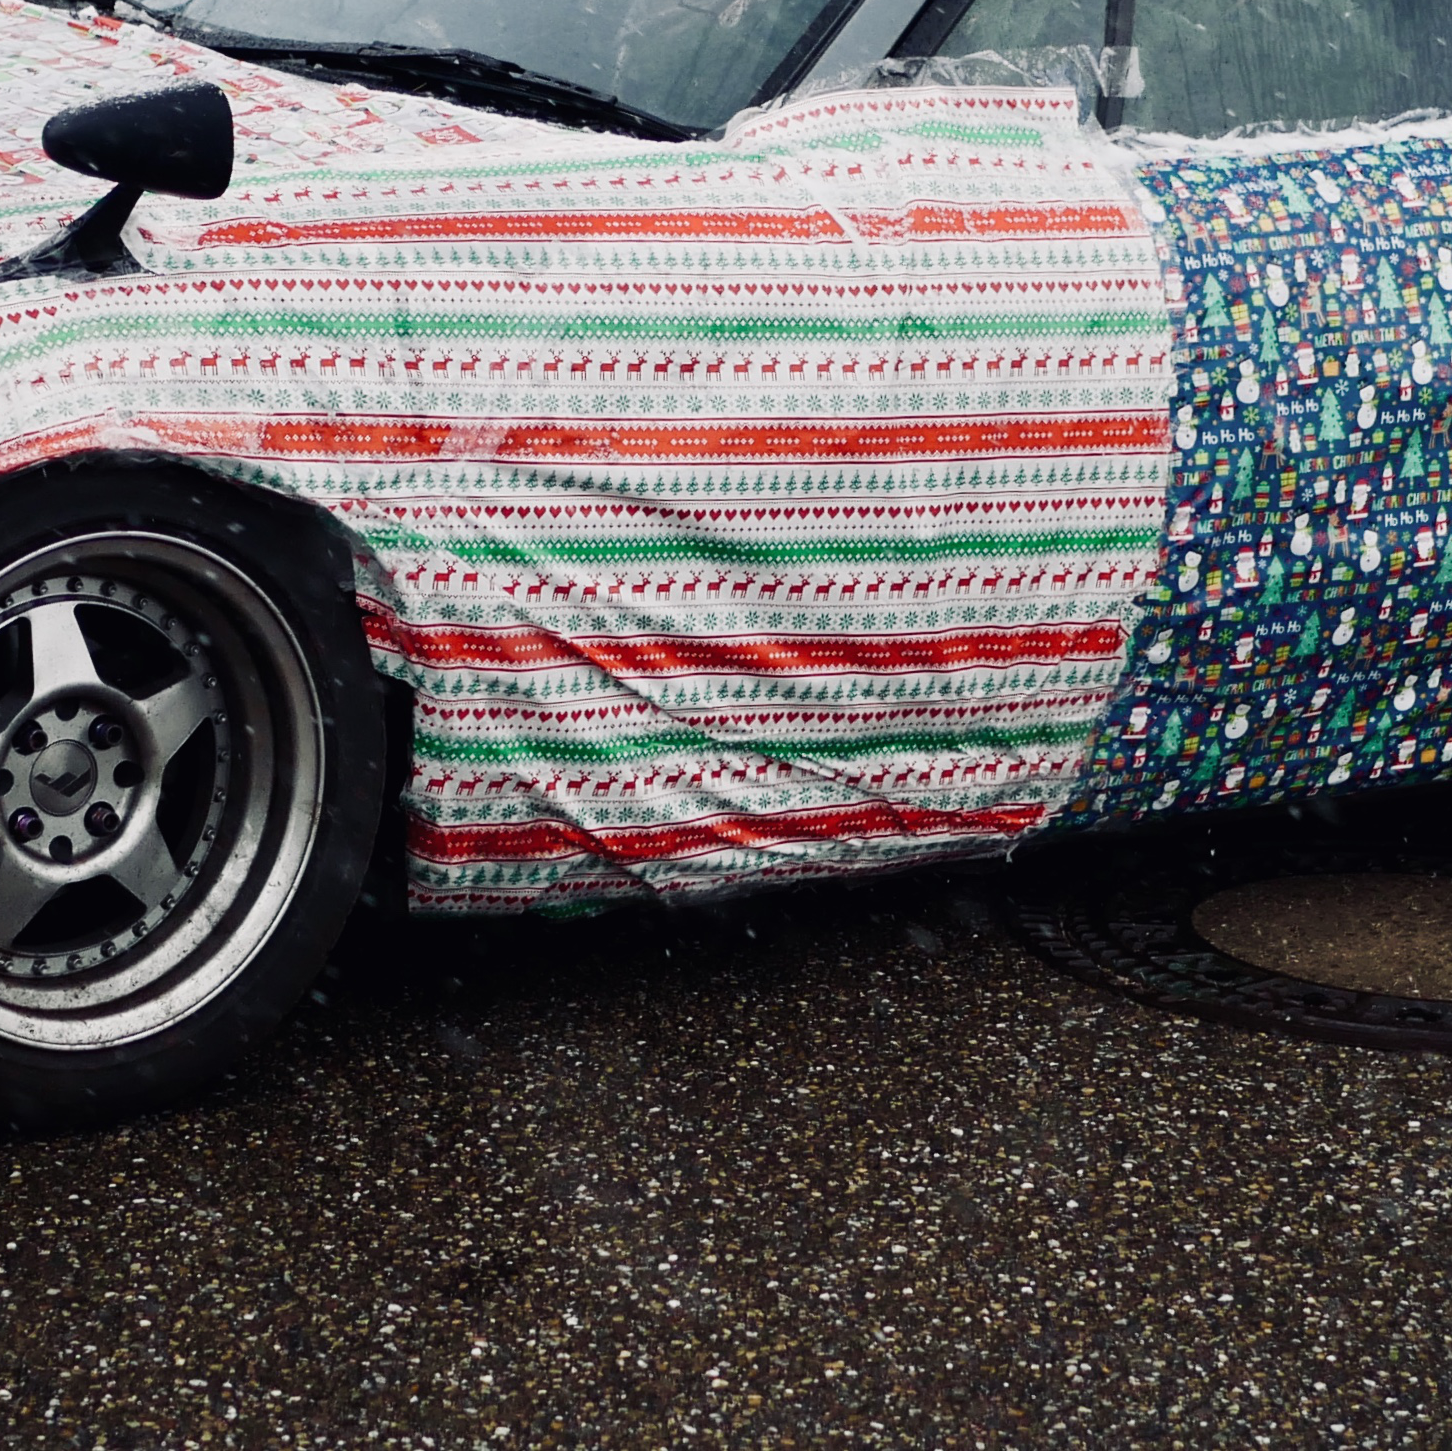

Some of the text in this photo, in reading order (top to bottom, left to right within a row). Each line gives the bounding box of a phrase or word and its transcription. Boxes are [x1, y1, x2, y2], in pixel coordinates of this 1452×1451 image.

[1359, 235, 1405, 251] Ho Ho Ho
[1184, 251, 1235, 270] Ho Ho Ho
[1314, 326, 1407, 347] MERRY CHRISTMAS
[1277, 398, 1319, 416] Ho Ho Ho
[1380, 407, 1425, 424] Ho Ho Ho
[1202, 428, 1255, 445] Ho Ho Ho
[1385, 510, 1429, 527] Ho Ho Ho
[1430, 602, 1443, 613] Ho
[1255, 621, 1301, 636] Ho Ho Ho
[1337, 671, 1381, 684] Ho Ho Ho
